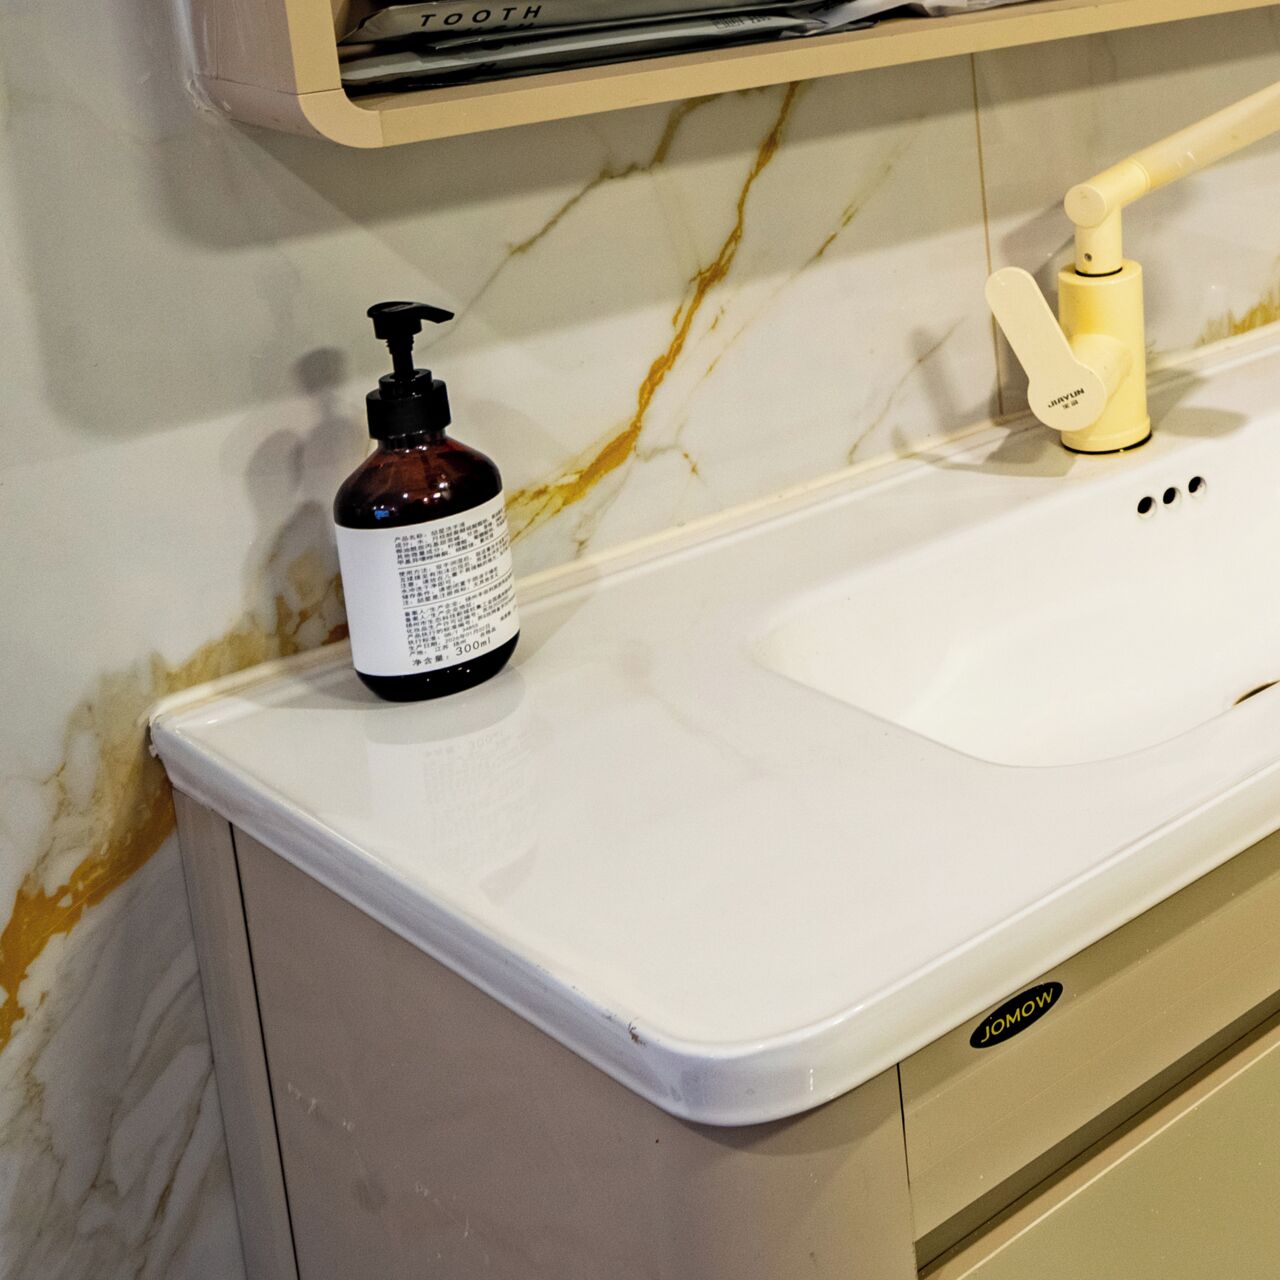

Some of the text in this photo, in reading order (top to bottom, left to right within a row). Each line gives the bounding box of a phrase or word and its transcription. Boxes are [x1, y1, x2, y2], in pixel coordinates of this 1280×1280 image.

[421, 5, 542, 27] TOOTH
[1048, 388, 1085, 408] JIAYUN
[456, 637, 491, 657] 300ml
[981, 987, 1053, 1043] JOMOW
